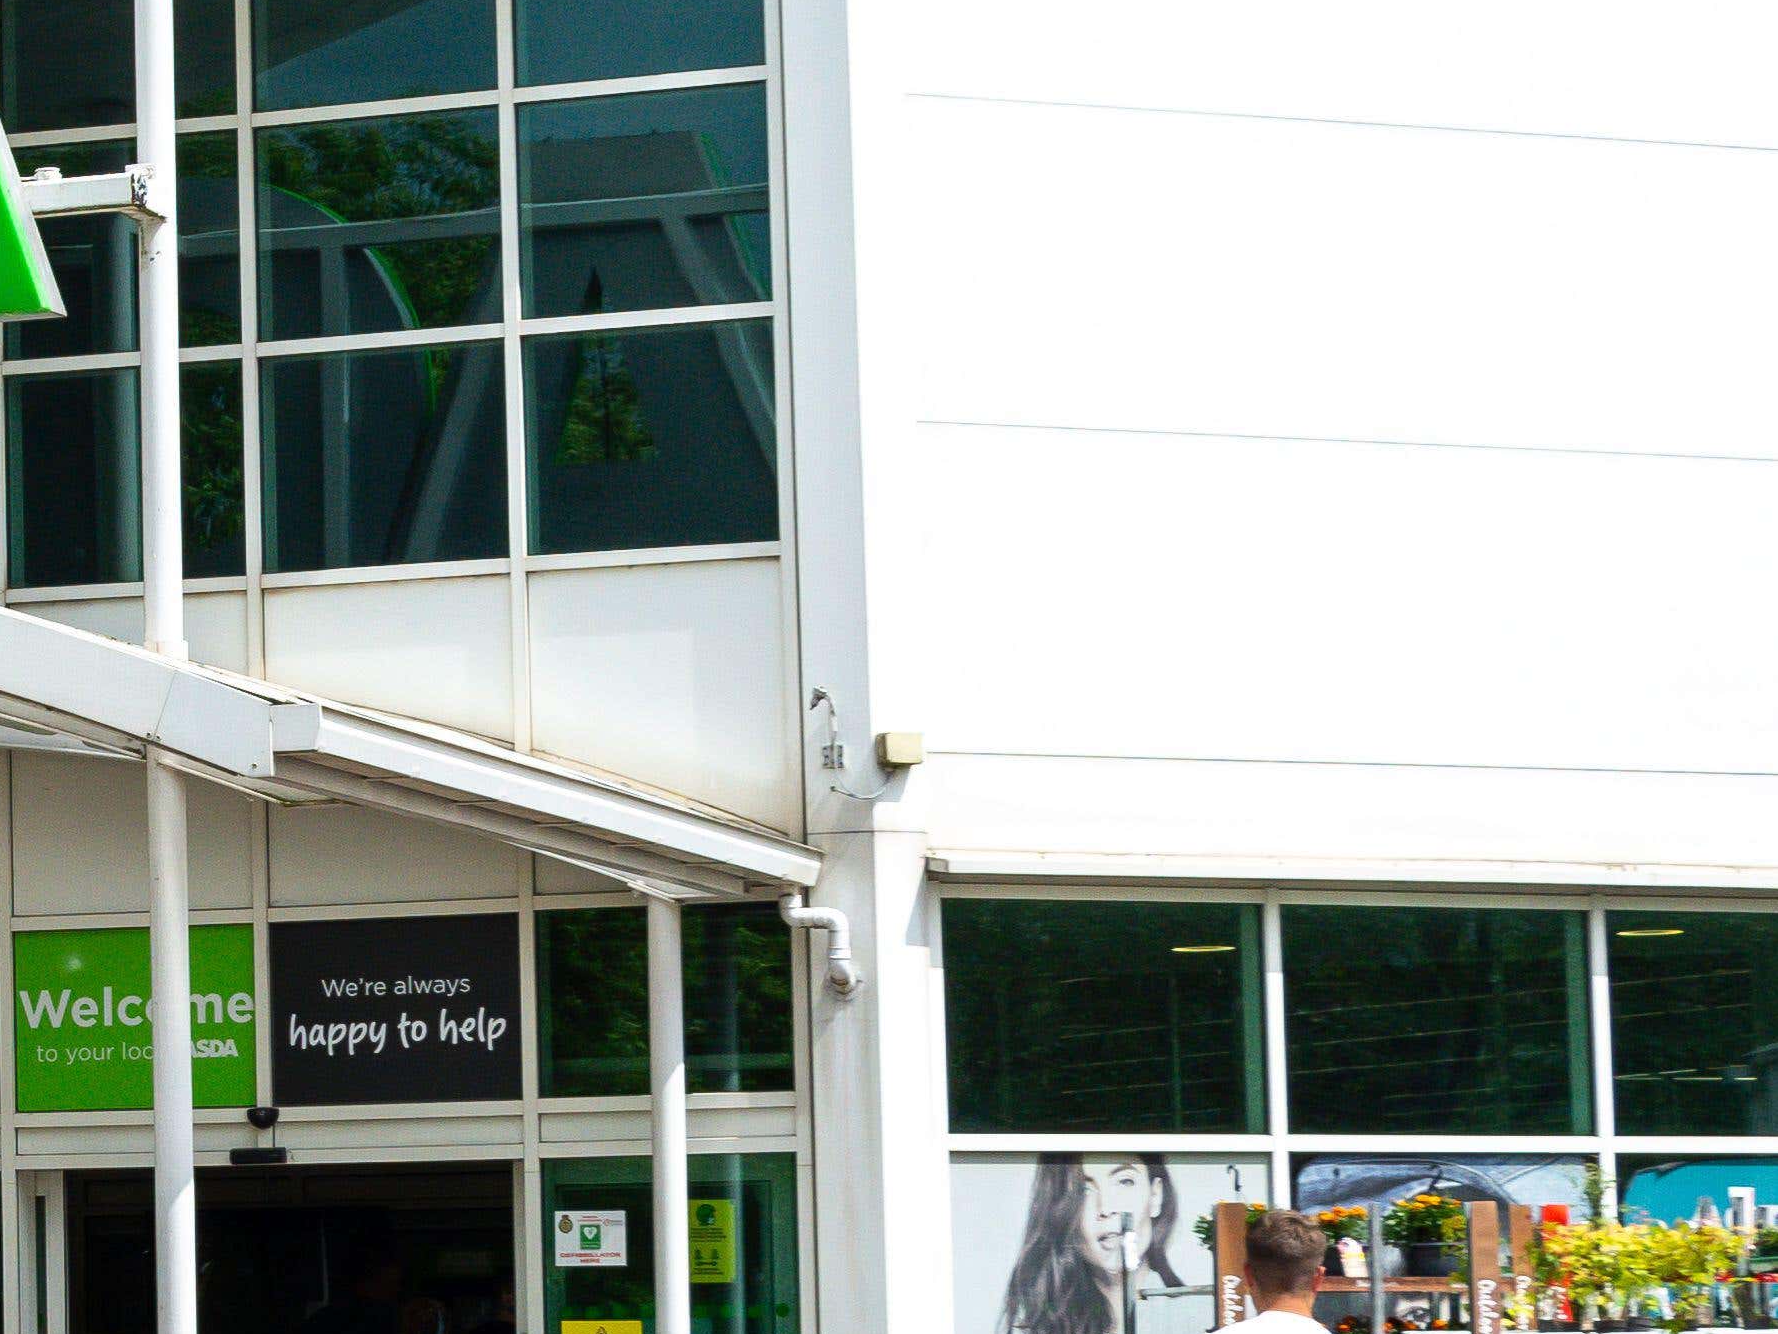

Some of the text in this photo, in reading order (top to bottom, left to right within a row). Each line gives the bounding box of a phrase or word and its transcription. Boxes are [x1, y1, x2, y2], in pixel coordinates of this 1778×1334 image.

[321, 976, 471, 998] We're always
[19, 986, 254, 1029] Welcme
[290, 1007, 507, 1056] happy to help
[36, 1045, 58, 1063] to
[66, 1045, 115, 1065] your
[122, 1042, 155, 1061] loc
